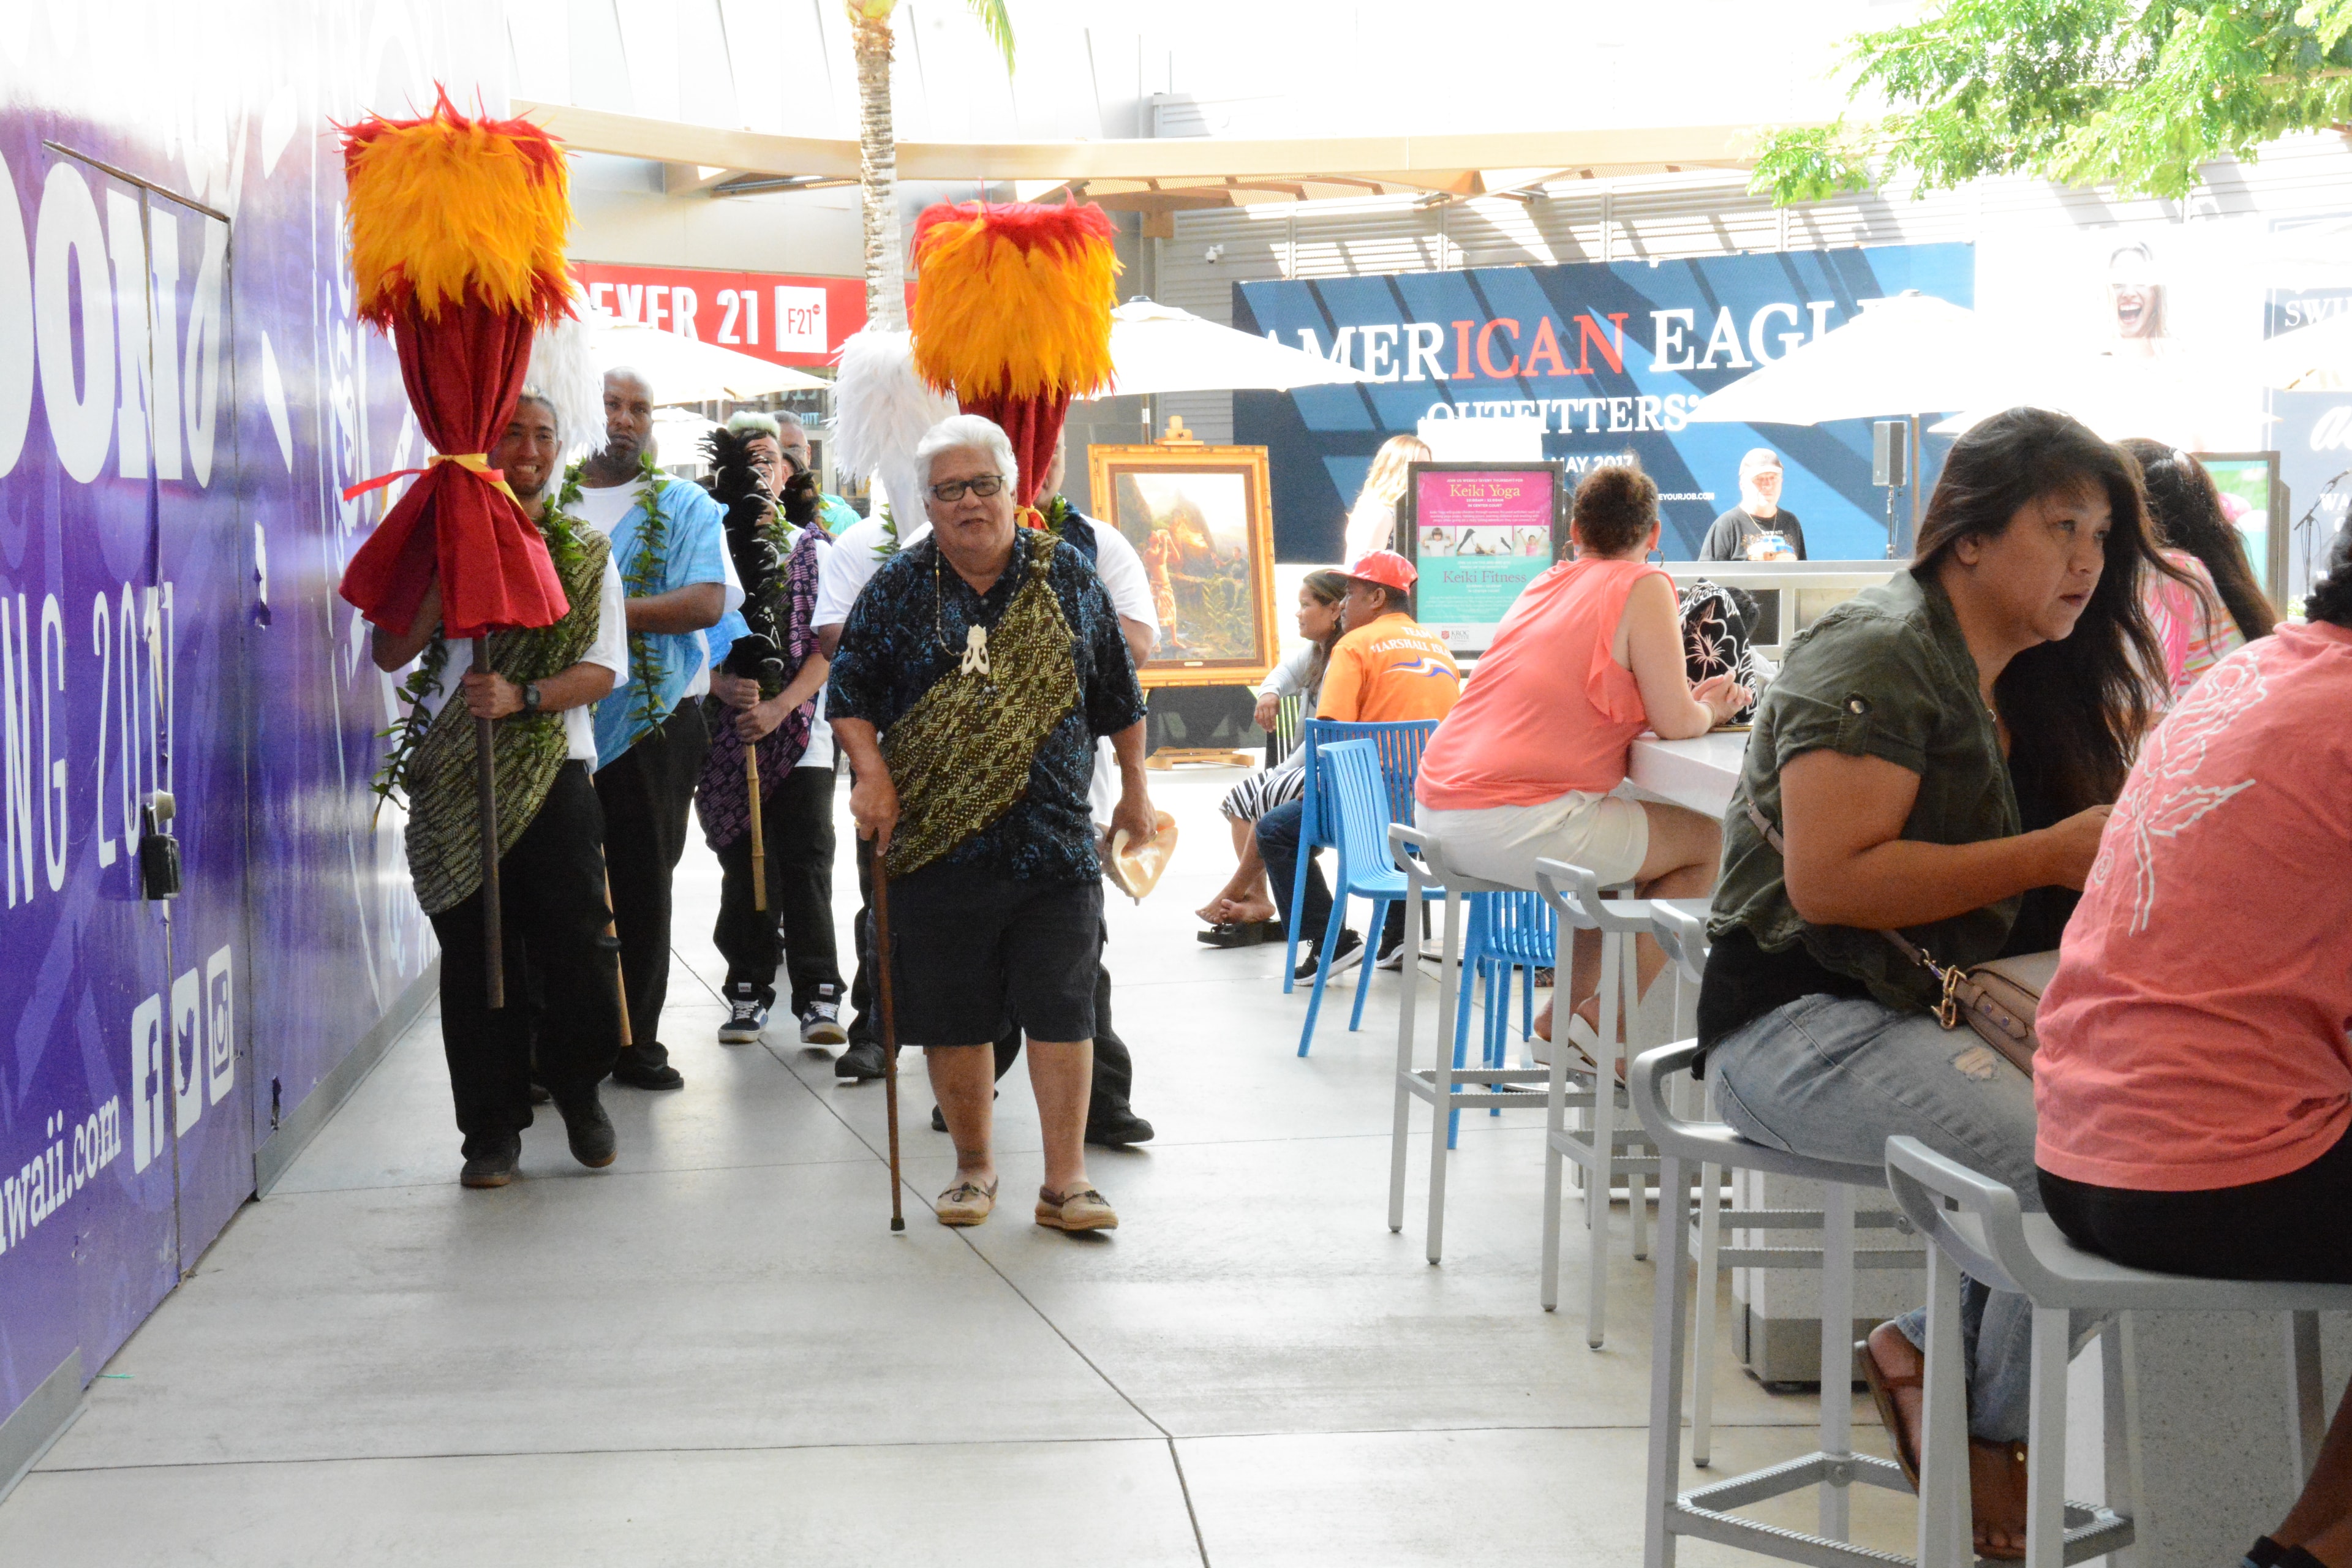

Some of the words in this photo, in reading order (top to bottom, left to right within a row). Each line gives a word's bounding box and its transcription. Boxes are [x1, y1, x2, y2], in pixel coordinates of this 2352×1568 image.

[717, 288, 758, 344] 21
[788, 308, 812, 334] F21
[2285, 297, 2352, 326] SWI
[1267, 312, 1629, 382] MERICAN
[1649, 300, 1885, 372] EAG
[1594, 455, 1634, 472] 2017
[1450, 484, 1485, 497] Keiki
[1488, 484, 1521, 499] Yoga
[1444, 571, 1477, 583] Keiki
[1482, 571, 1527, 583] Fitness
[1401, 626, 1433, 639] TEAM
[1370, 638, 1430, 653] MARSHALL
[0, 1095, 121, 1256] waii.com
